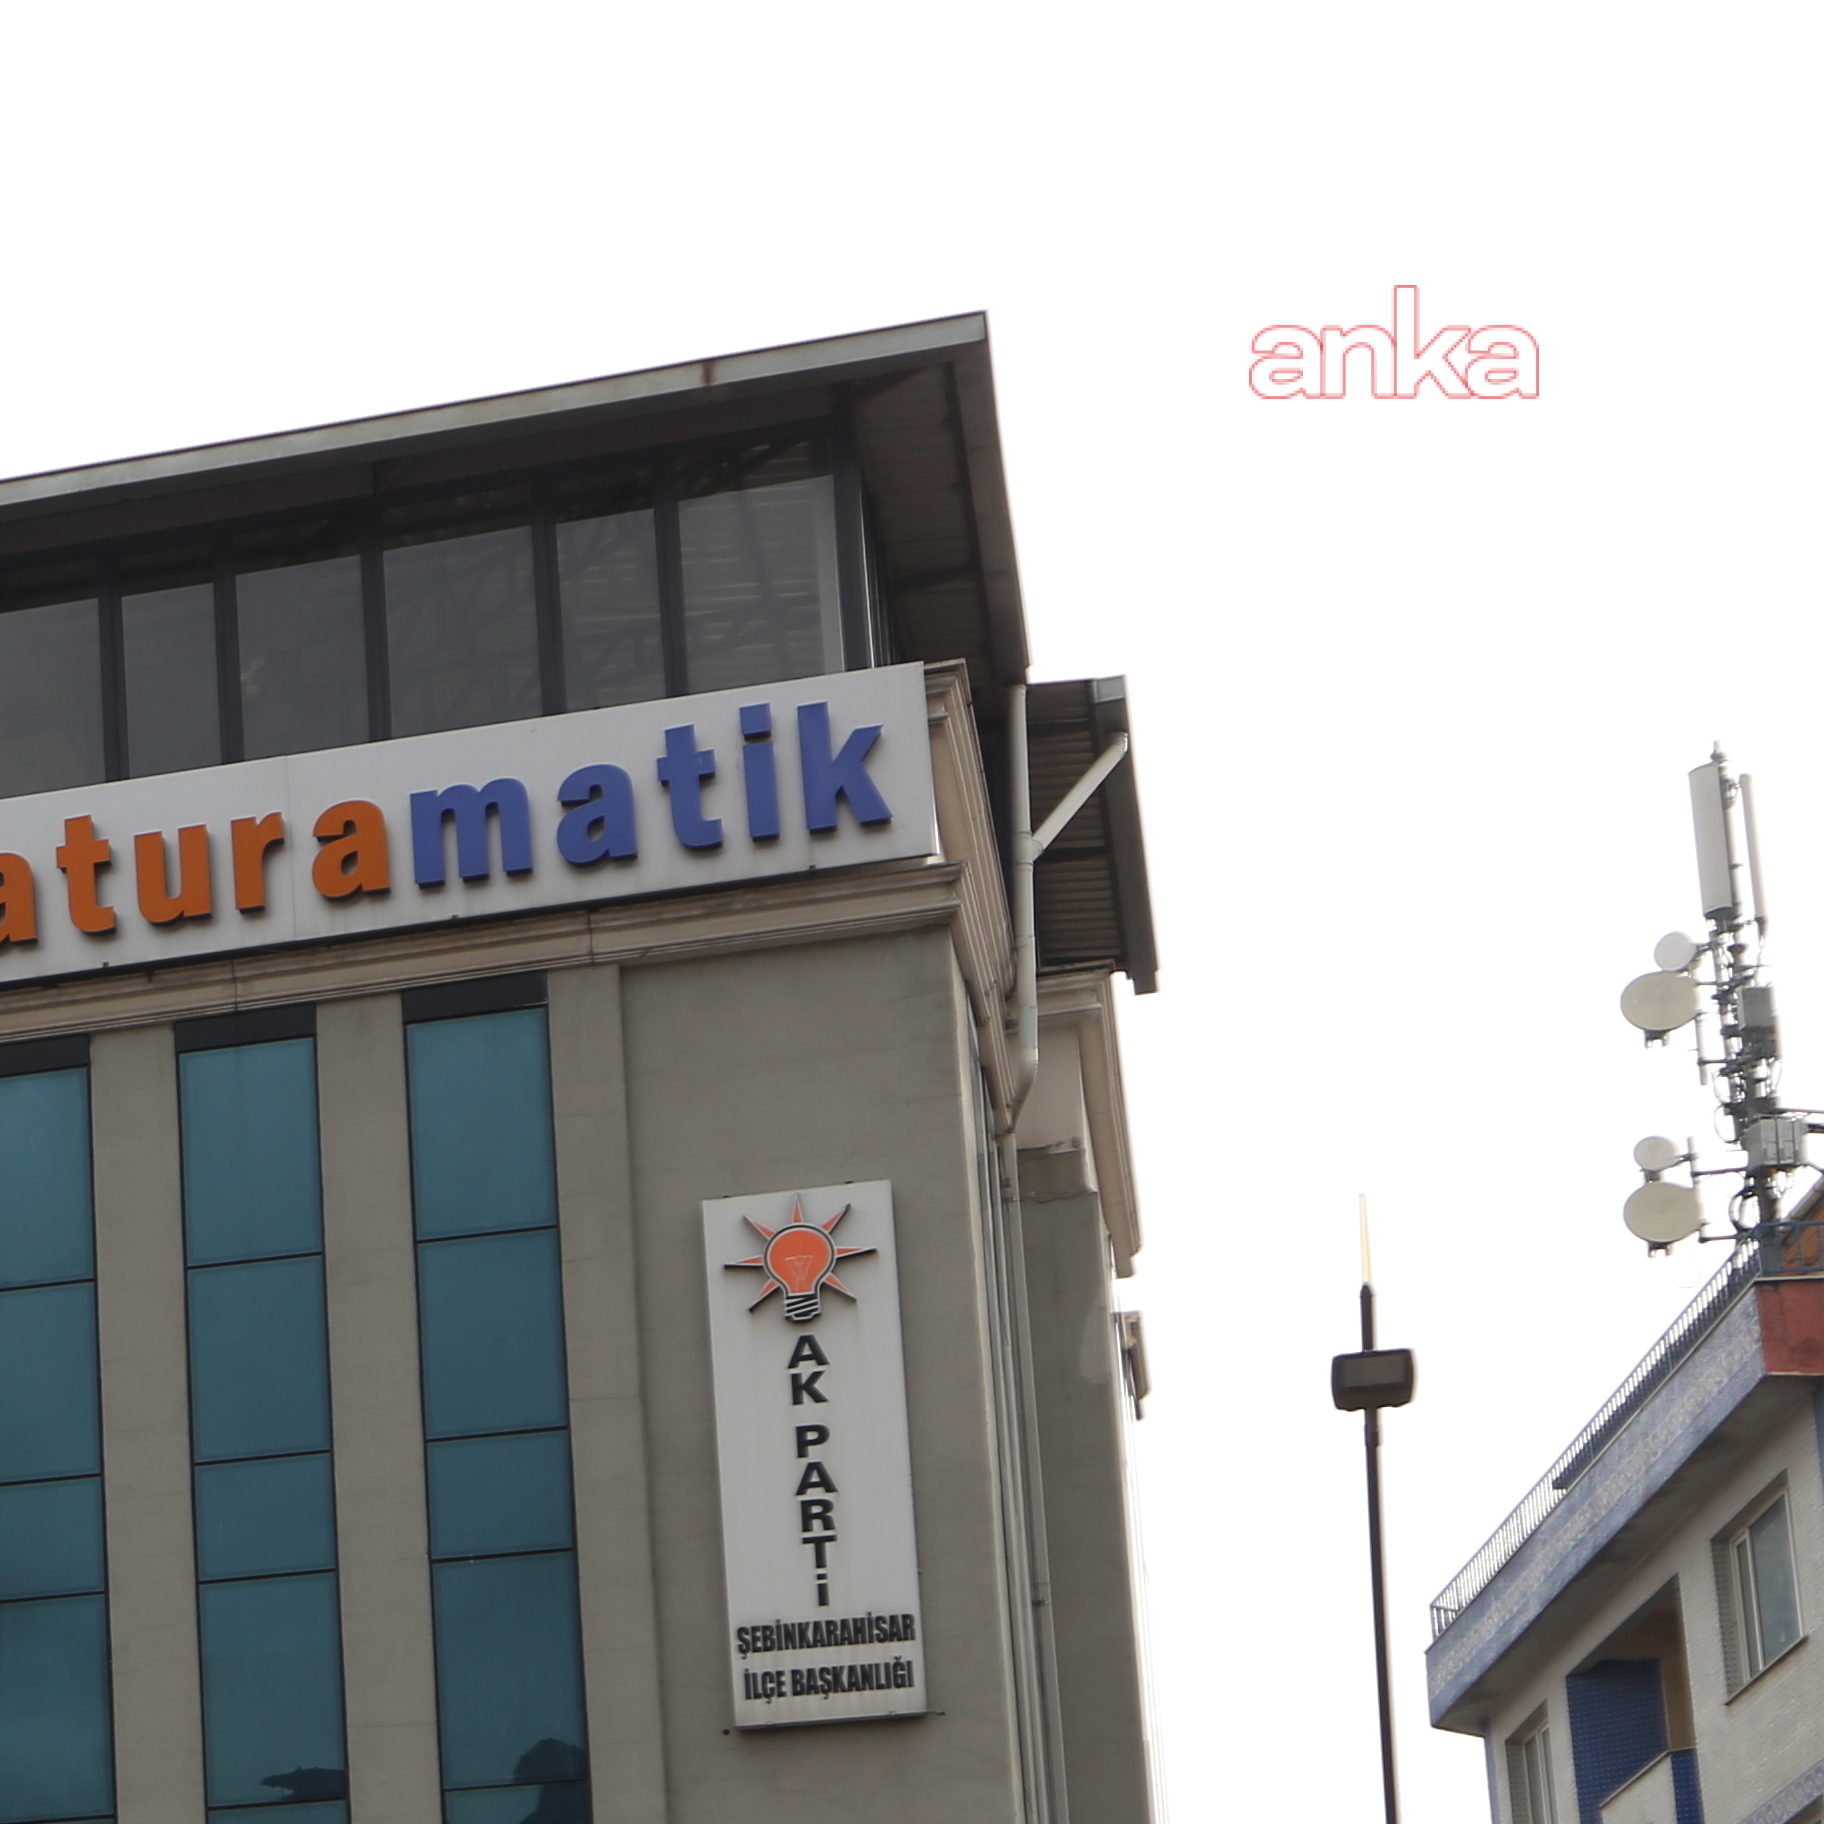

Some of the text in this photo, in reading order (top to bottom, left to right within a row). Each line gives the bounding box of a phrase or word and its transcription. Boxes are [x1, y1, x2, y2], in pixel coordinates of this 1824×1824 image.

[787, 1334, 829, 1406] AK
[737, 1611, 916, 1658] ŞEBİNKARAHİSAR
[743, 1656, 914, 1704] İLÇE BAŞKANLIĞI
